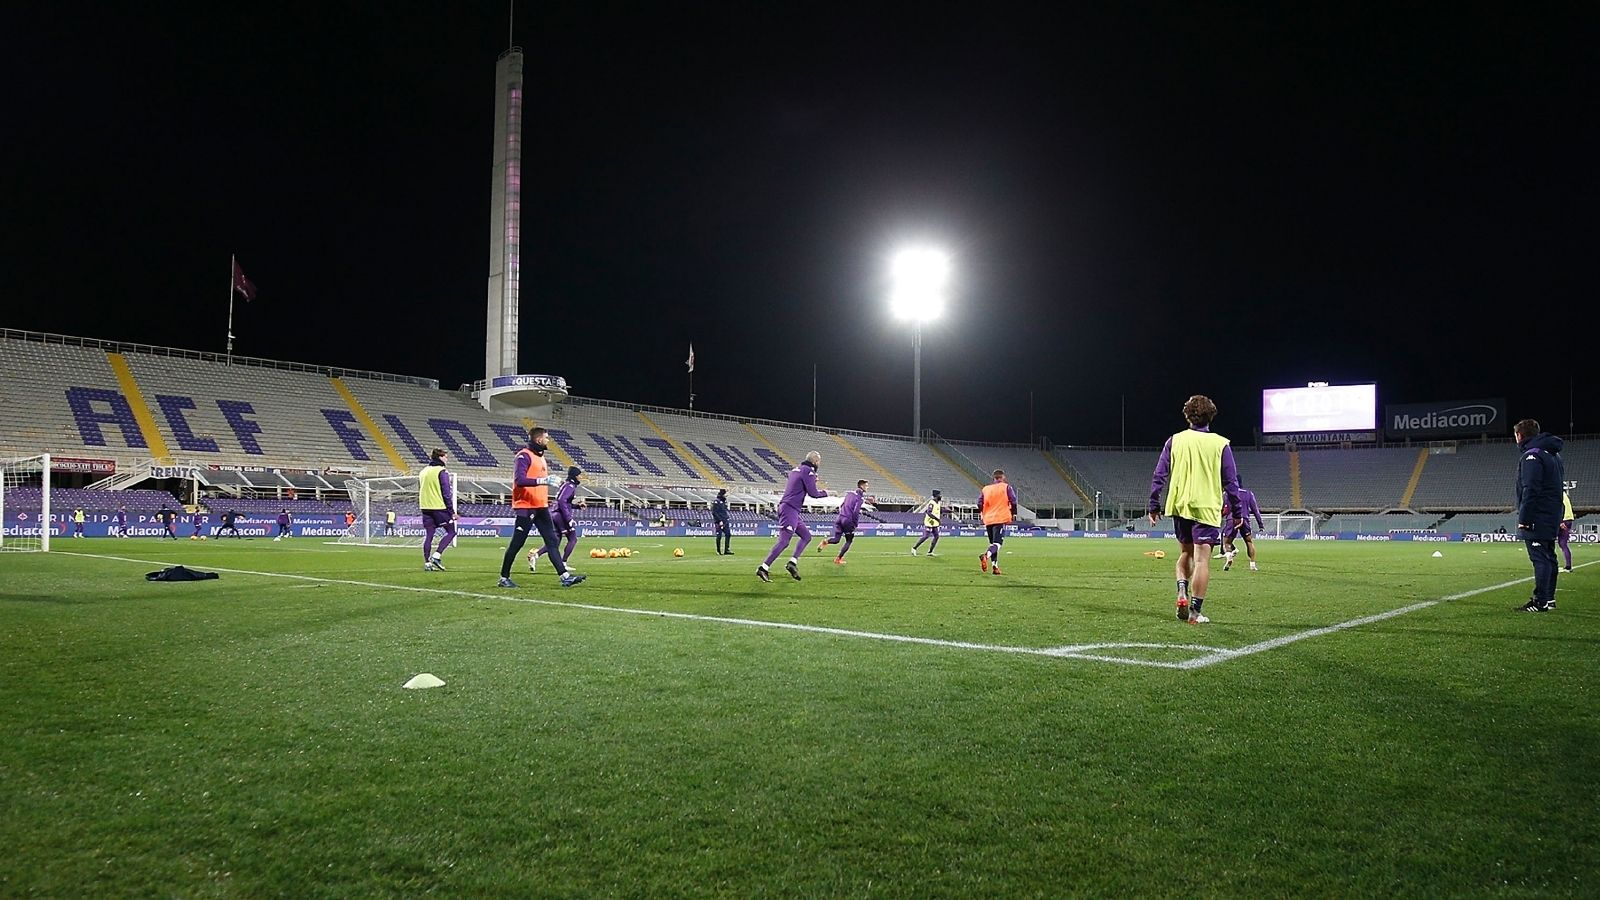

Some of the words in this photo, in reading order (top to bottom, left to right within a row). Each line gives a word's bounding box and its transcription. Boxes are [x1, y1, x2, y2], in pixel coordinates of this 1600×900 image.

[65, 386, 265, 456] ACF
[1394, 412, 1487, 430] Mediacom
[1286, 433, 1351, 443] SAMMONTANA
[210, 526, 266, 536] Medacom
[457, 528, 497, 536] Mediacom
[581, 528, 615, 536] Mediacom
[635, 528, 666, 536] Mediacom
[685, 528, 713, 536] Mediacom
[1412, 534, 1448, 542] Mediacom
